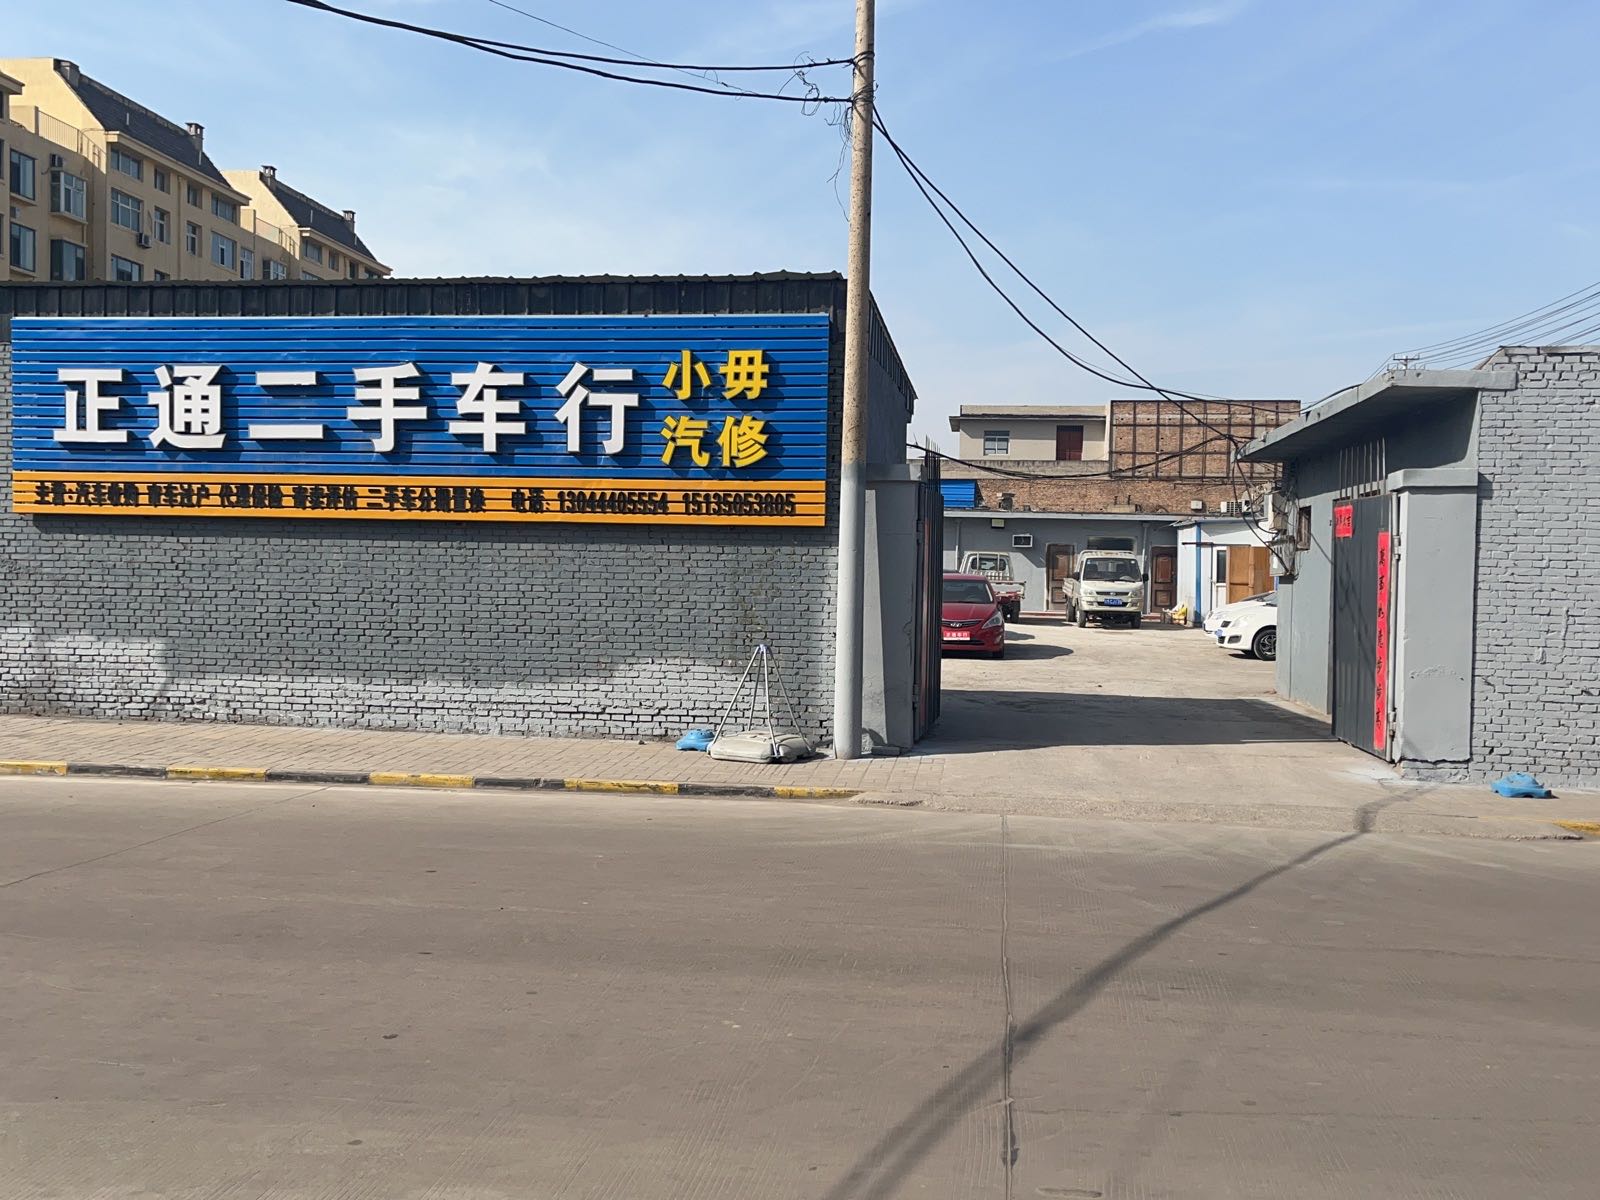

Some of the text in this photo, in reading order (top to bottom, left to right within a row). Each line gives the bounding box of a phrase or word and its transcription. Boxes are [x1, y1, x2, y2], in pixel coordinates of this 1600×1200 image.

[53, 361, 639, 453] 正通二手车行
[660, 414, 769, 468] 汽修
